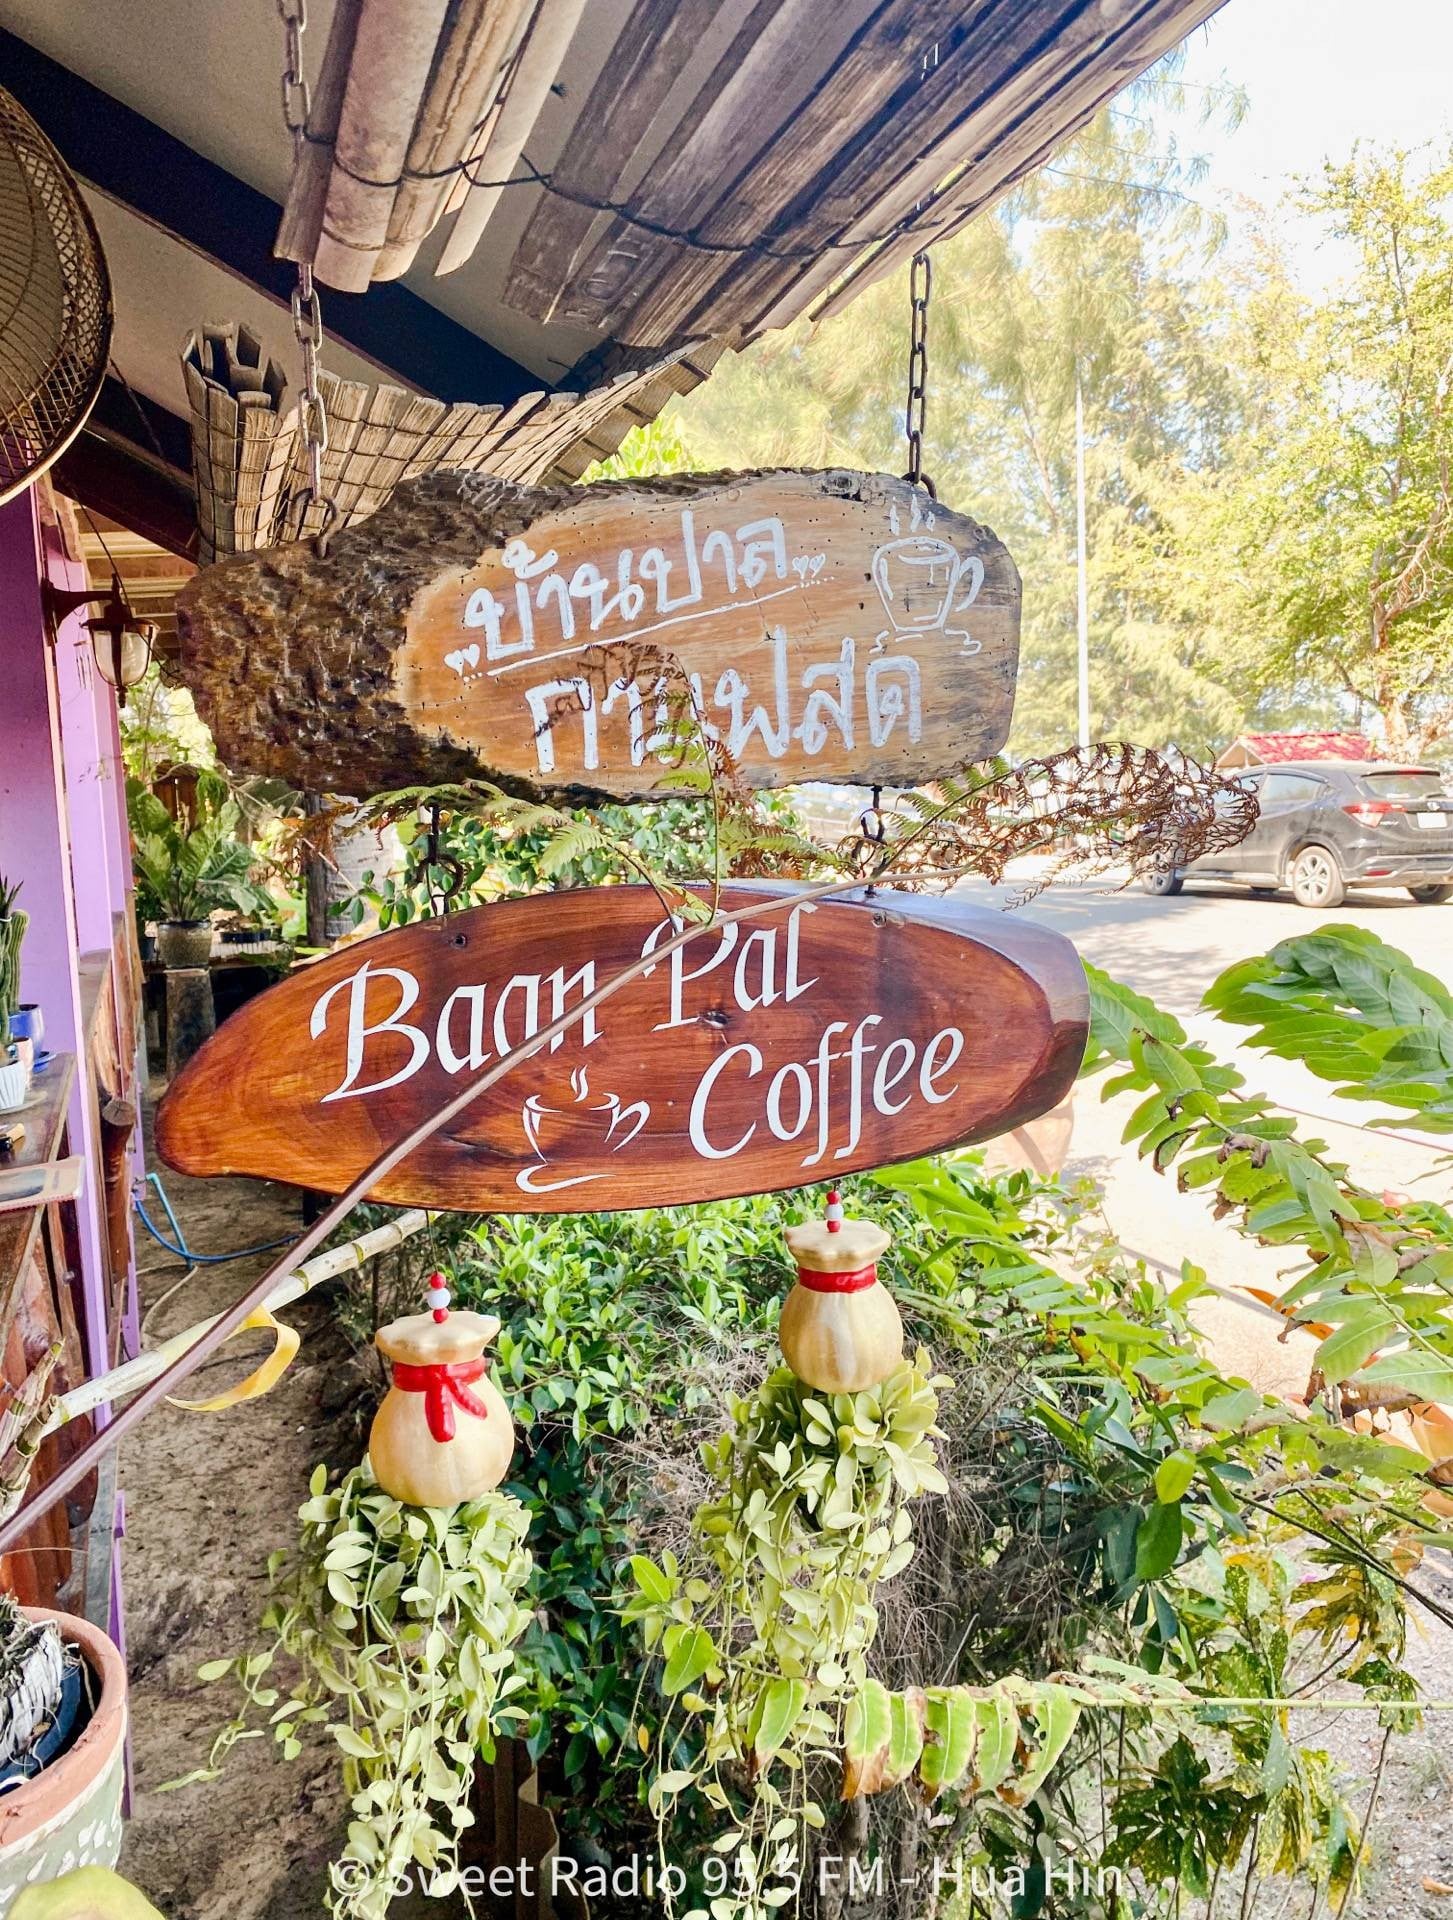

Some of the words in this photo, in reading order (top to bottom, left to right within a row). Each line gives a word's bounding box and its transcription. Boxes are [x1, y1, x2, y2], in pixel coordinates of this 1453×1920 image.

[464, 509, 788, 661] บ้านปาล
[309, 958, 604, 1103] Baan
[640, 902, 820, 1032] Pal
[688, 1014, 965, 1167] Coffee
